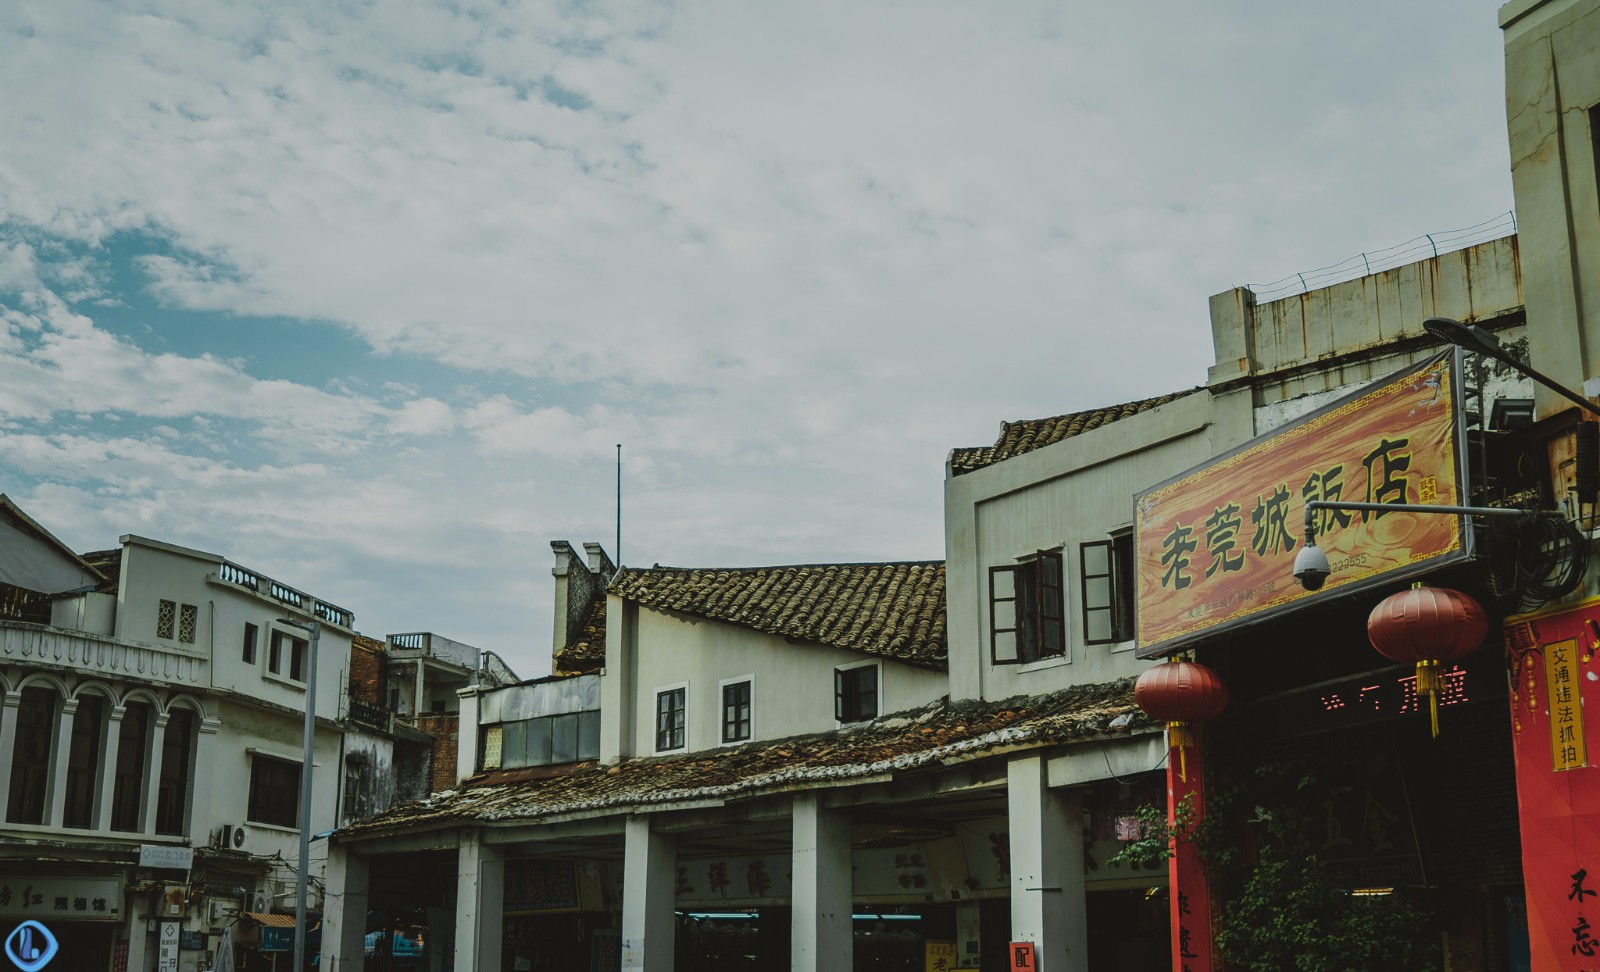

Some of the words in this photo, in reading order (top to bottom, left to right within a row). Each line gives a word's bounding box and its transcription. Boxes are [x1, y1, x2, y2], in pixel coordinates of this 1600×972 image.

[1161, 437, 1413, 591] 老莞城飯店
[1553, 646, 1577, 764] 交通违法抓拍
[1568, 868, 1600, 957] 不忘
